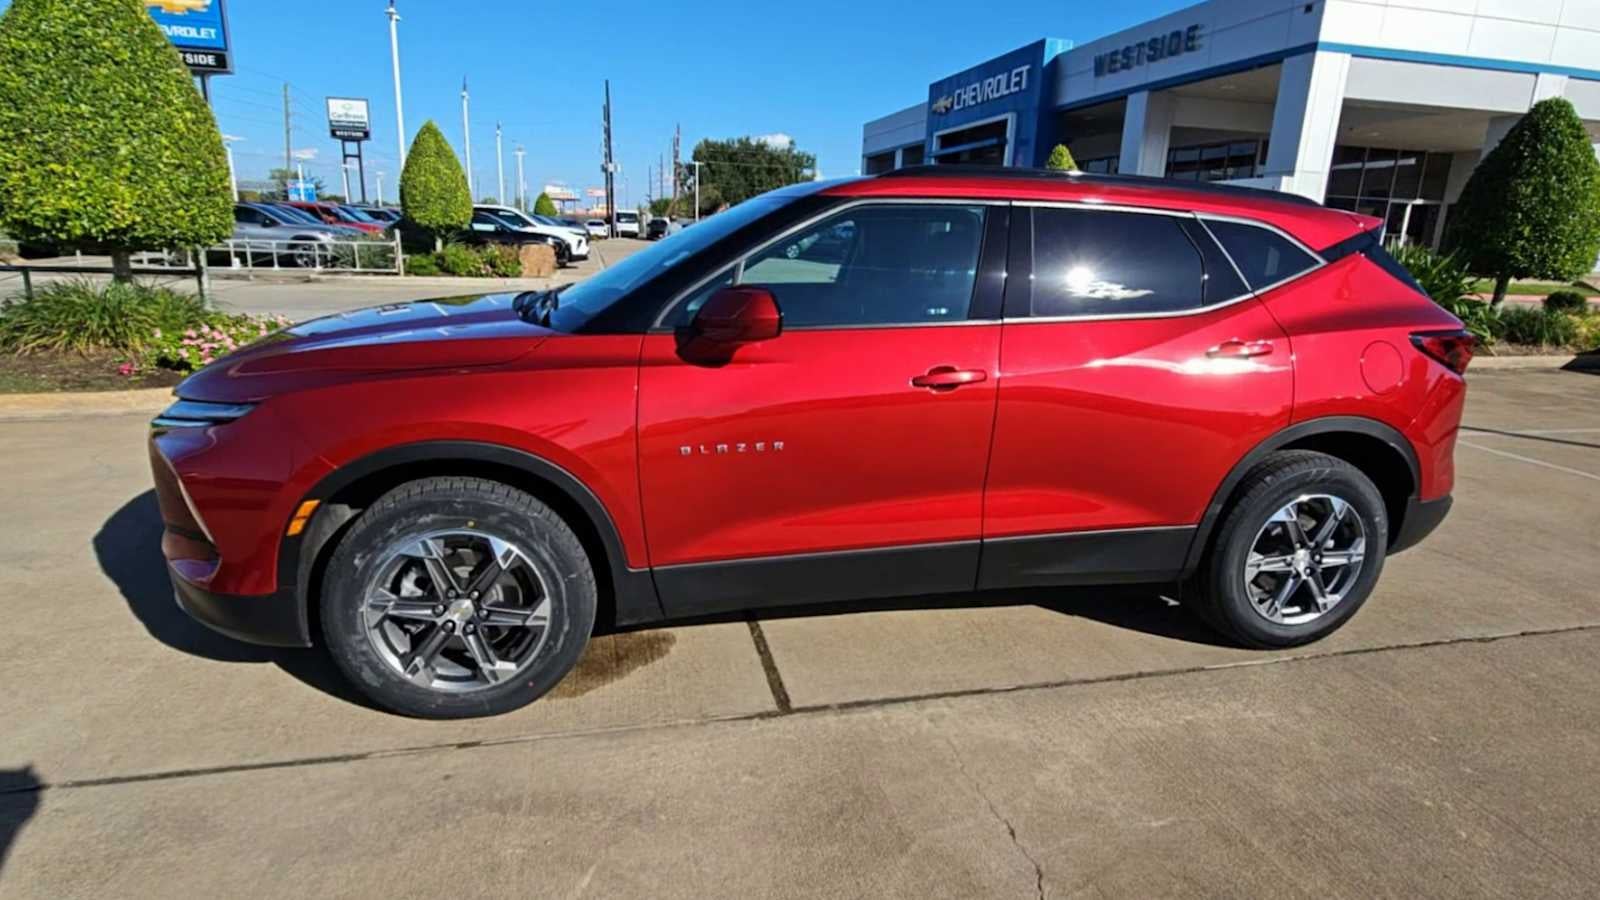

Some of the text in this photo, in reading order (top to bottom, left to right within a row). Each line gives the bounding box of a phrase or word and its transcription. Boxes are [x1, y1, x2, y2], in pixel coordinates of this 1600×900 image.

[1093, 23, 1203, 77] WESTSIDE
[953, 64, 1031, 111] CHEVROLET
[679, 441, 785, 456] BLAZER
